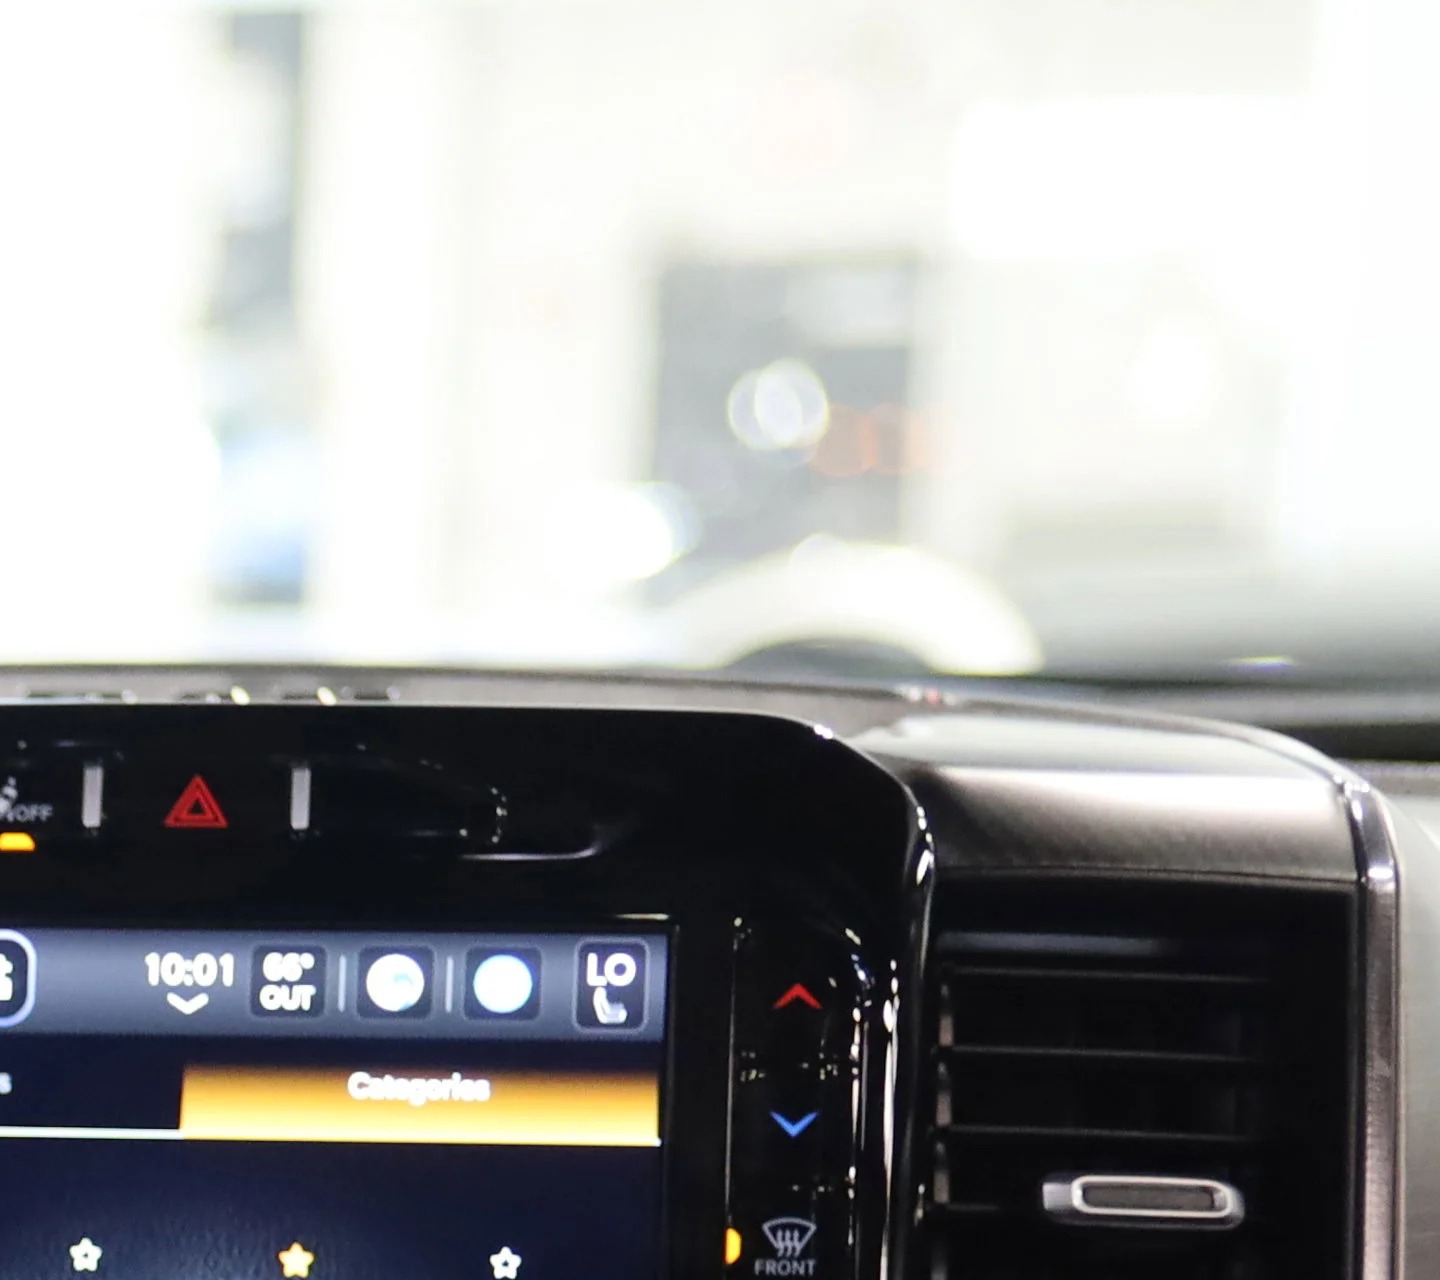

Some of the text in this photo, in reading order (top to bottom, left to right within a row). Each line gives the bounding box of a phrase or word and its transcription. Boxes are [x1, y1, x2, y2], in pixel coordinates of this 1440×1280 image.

[145, 952, 234, 987] 10:01
[586, 952, 637, 986] LO
[259, 984, 317, 1011] OUT
[347, 1071, 491, 1105] Categories
[754, 1259, 817, 1276] FRONT
